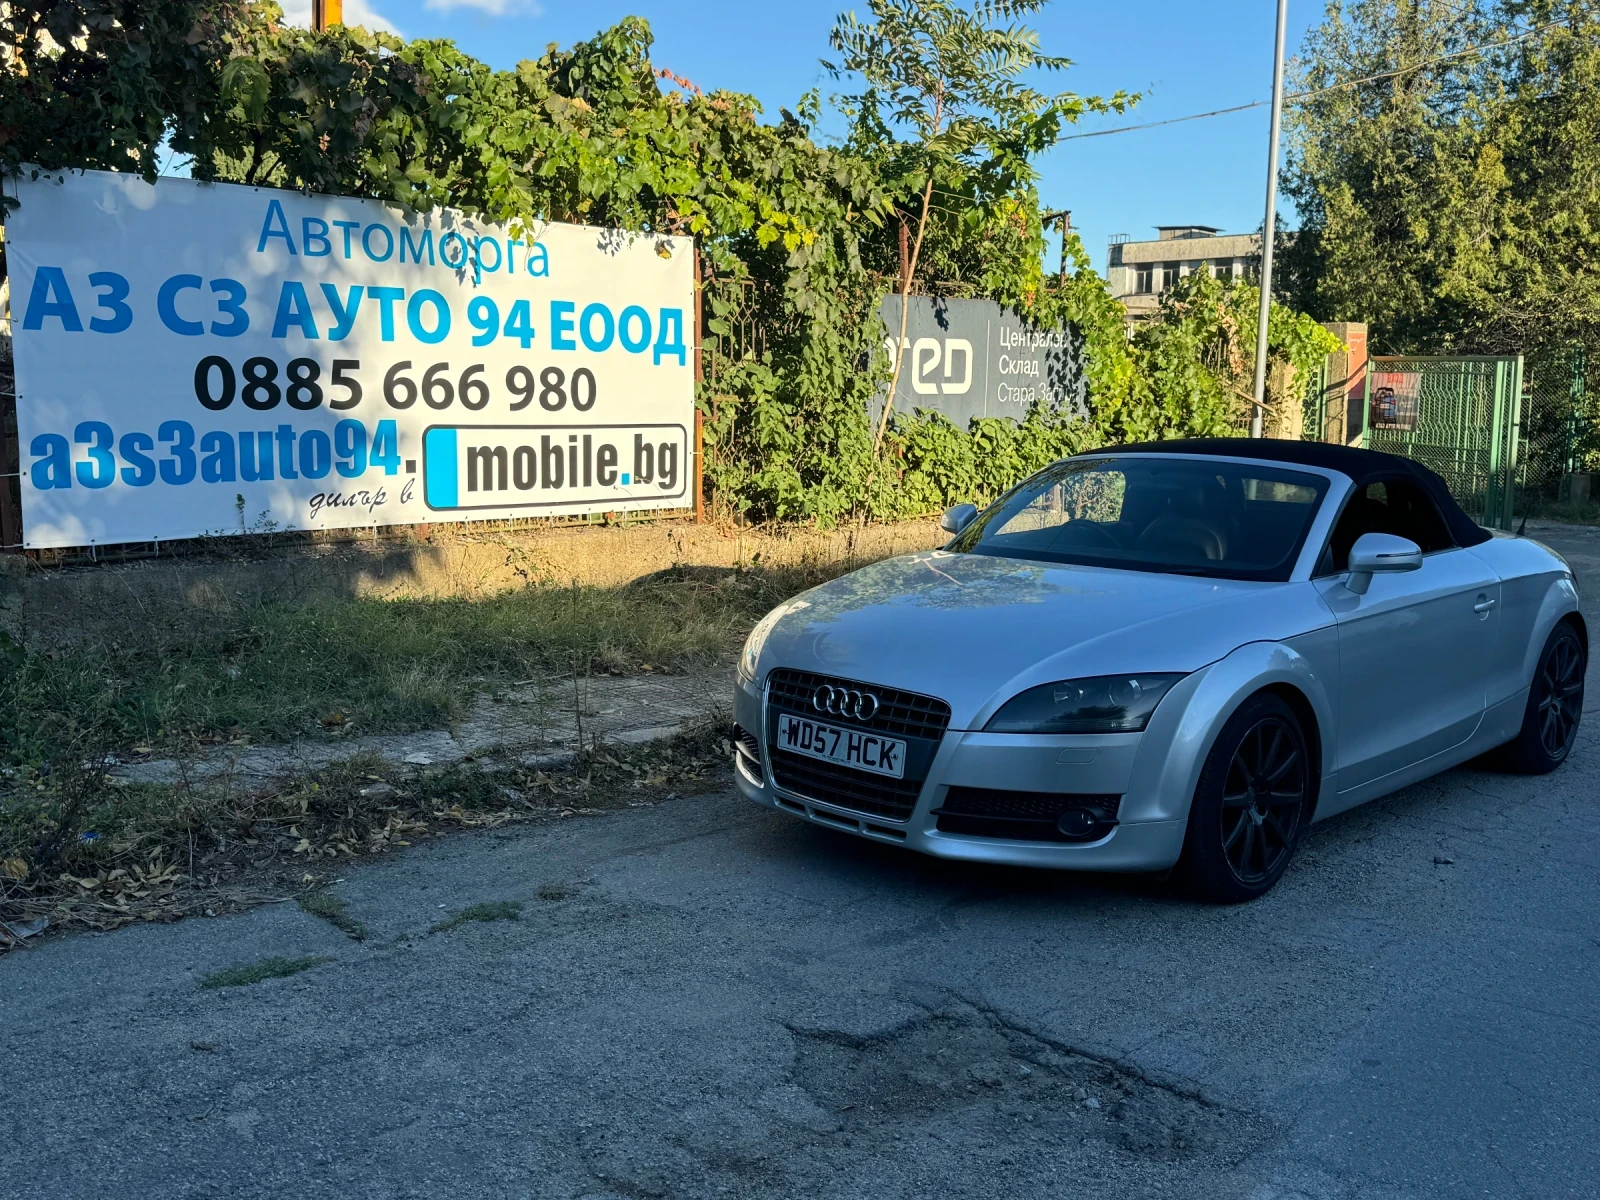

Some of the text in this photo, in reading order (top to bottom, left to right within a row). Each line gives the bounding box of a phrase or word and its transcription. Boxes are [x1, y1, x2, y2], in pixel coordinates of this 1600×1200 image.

[257, 198, 549, 284] Автоморга
[22, 265, 133, 334] А3
[271, 280, 451, 344] АУТО
[467, 295, 535, 349] 94
[550, 300, 687, 366] ЕООД
[193, 355, 598, 412] 0885 666 980
[998, 354, 1040, 378] Склад
[997, 382, 1036, 407] Стара
[466, 433, 679, 493] mobile.bg
[308, 486, 389, 518] дилър
[786, 717, 896, 771] WD57 HCK
